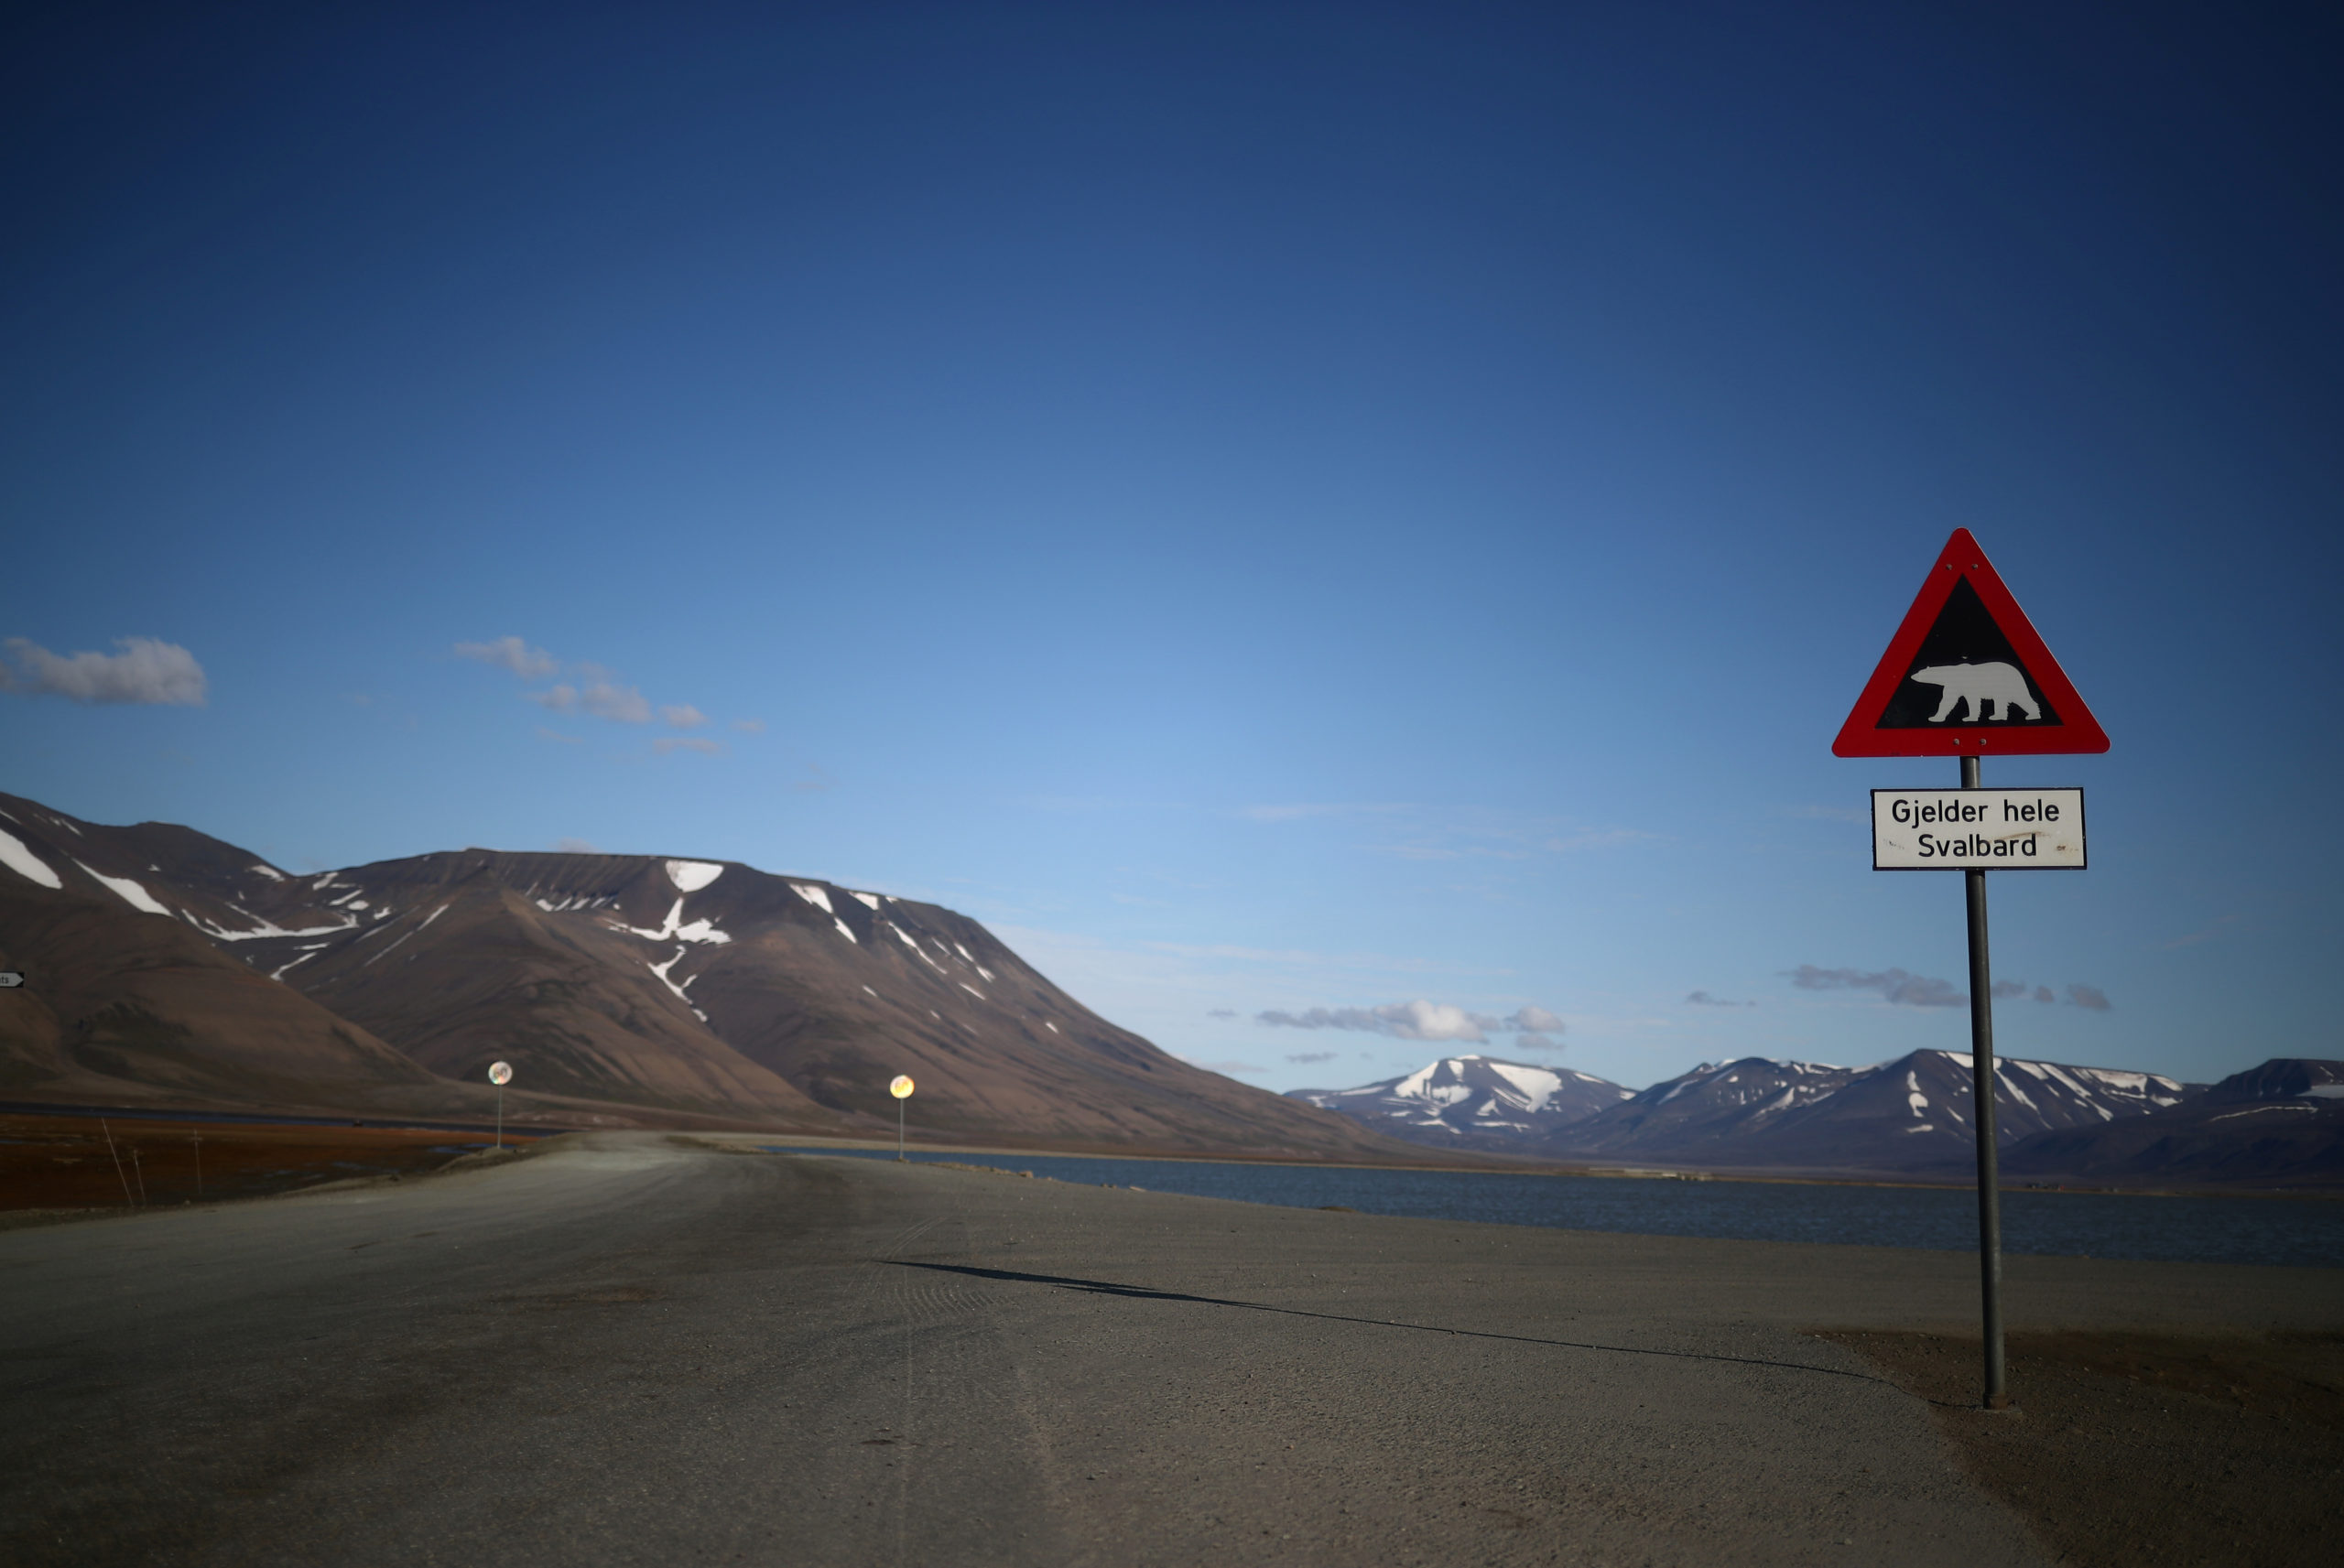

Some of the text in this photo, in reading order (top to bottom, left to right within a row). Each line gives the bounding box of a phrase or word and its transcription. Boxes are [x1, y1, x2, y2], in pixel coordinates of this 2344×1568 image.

[1892, 799, 2059, 828] Gjelder hele
[1918, 833, 2036, 857] Svalbard
